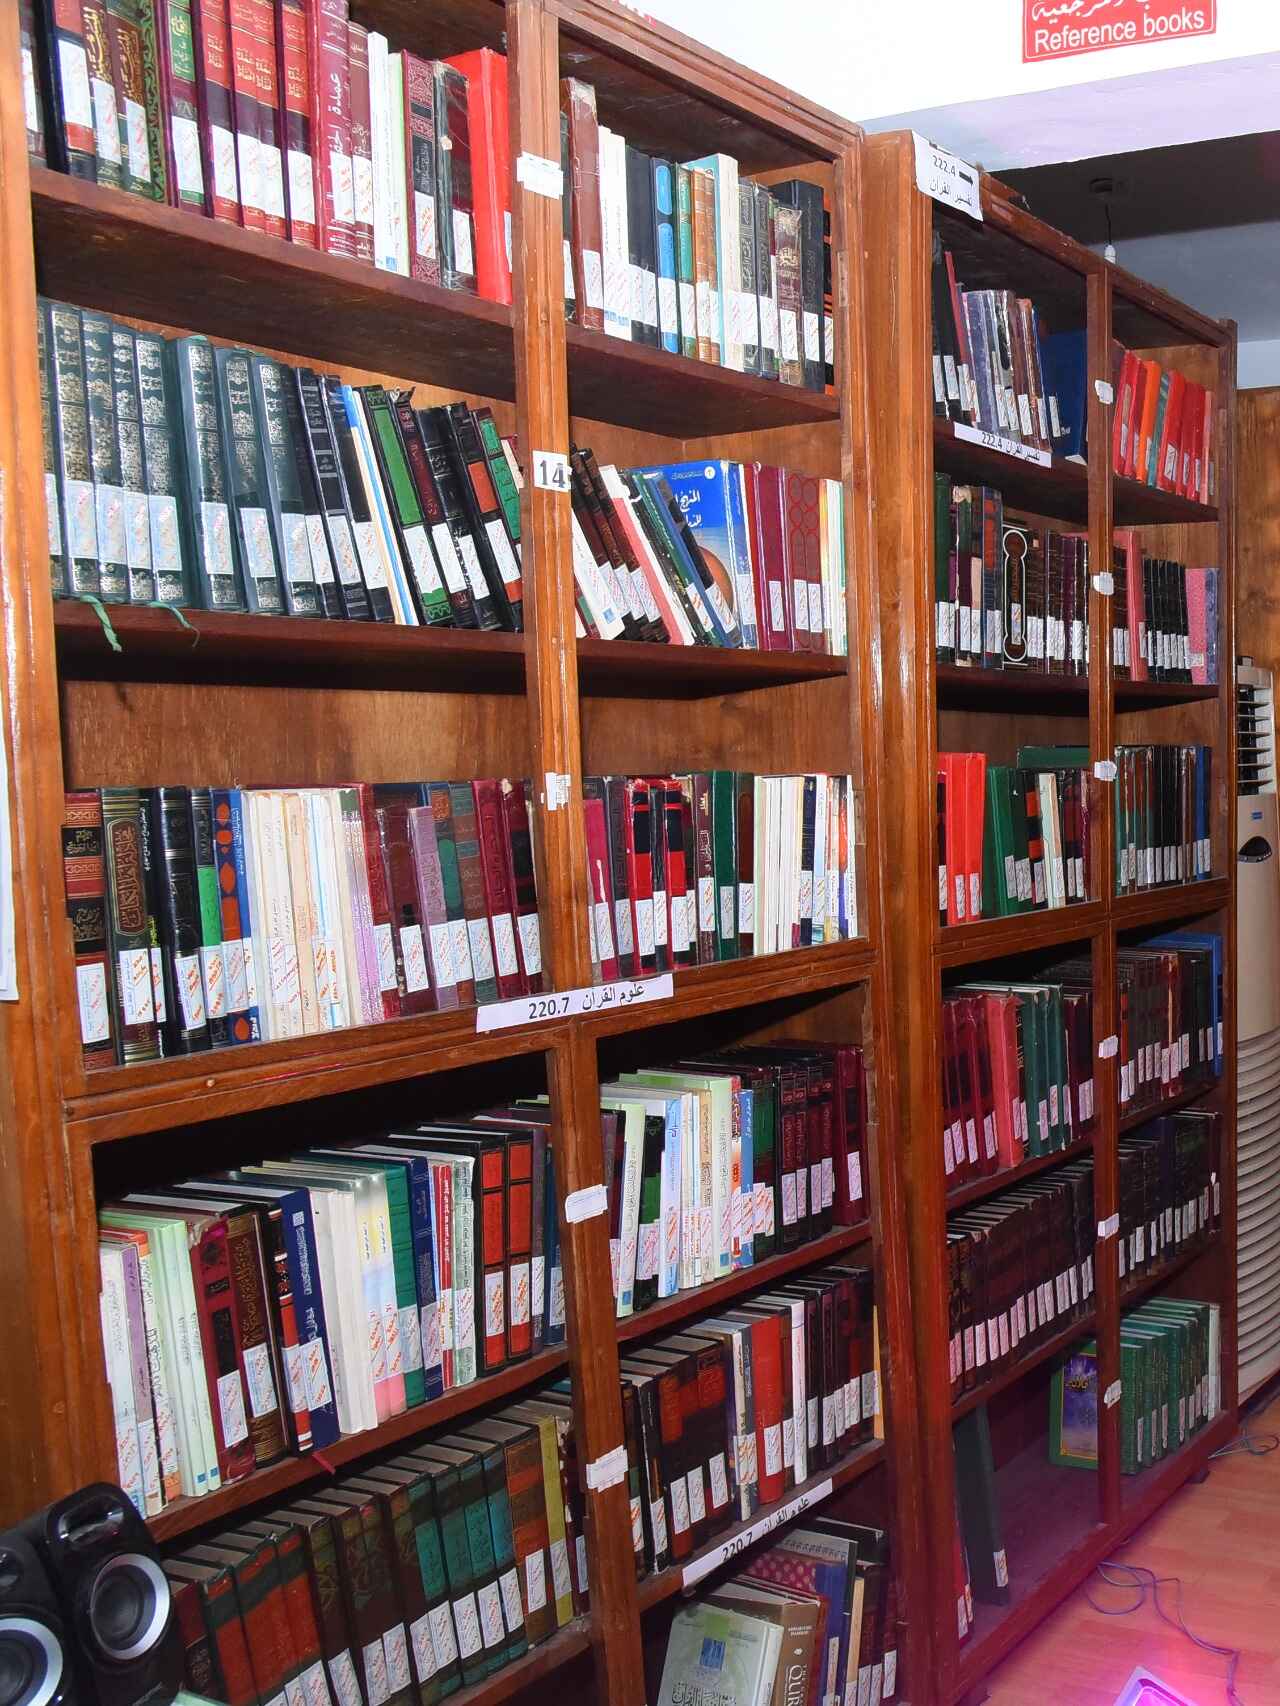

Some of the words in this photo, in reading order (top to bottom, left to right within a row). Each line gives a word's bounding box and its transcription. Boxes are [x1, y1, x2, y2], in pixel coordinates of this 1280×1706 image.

[1034, 21, 1137, 53] Reference
[1143, 8, 1205, 36] books
[932, 155, 956, 176] 222.4
[981, 431, 1003, 449] 222.4
[539, 460, 566, 488] 14
[619, 983, 645, 1006] علوم
[528, 997, 570, 1019] 220.7
[721, 1532, 753, 1561] 2207
